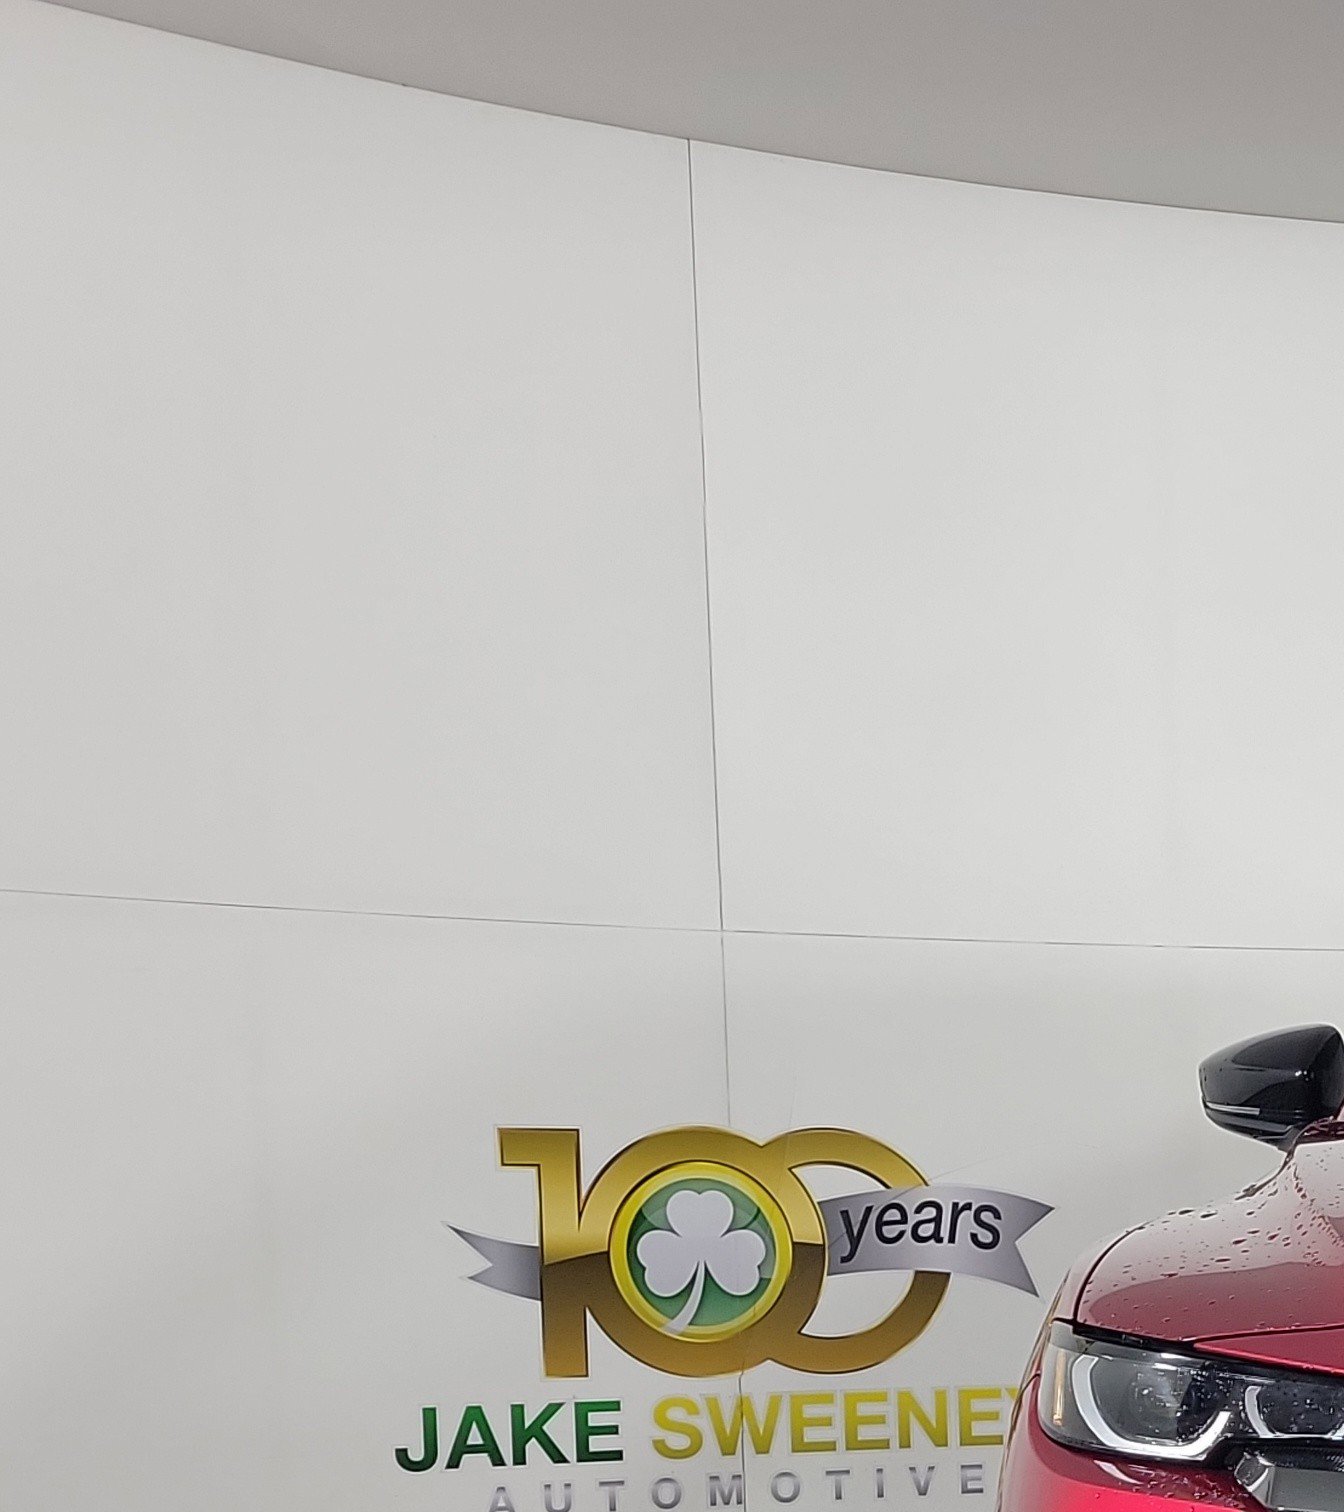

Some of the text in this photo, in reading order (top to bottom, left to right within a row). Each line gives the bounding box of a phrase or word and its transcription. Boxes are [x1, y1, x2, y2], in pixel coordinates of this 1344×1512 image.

[499, 1126, 1002, 1378] 100 years
[395, 1387, 1018, 1472] JAKE SWEENE
